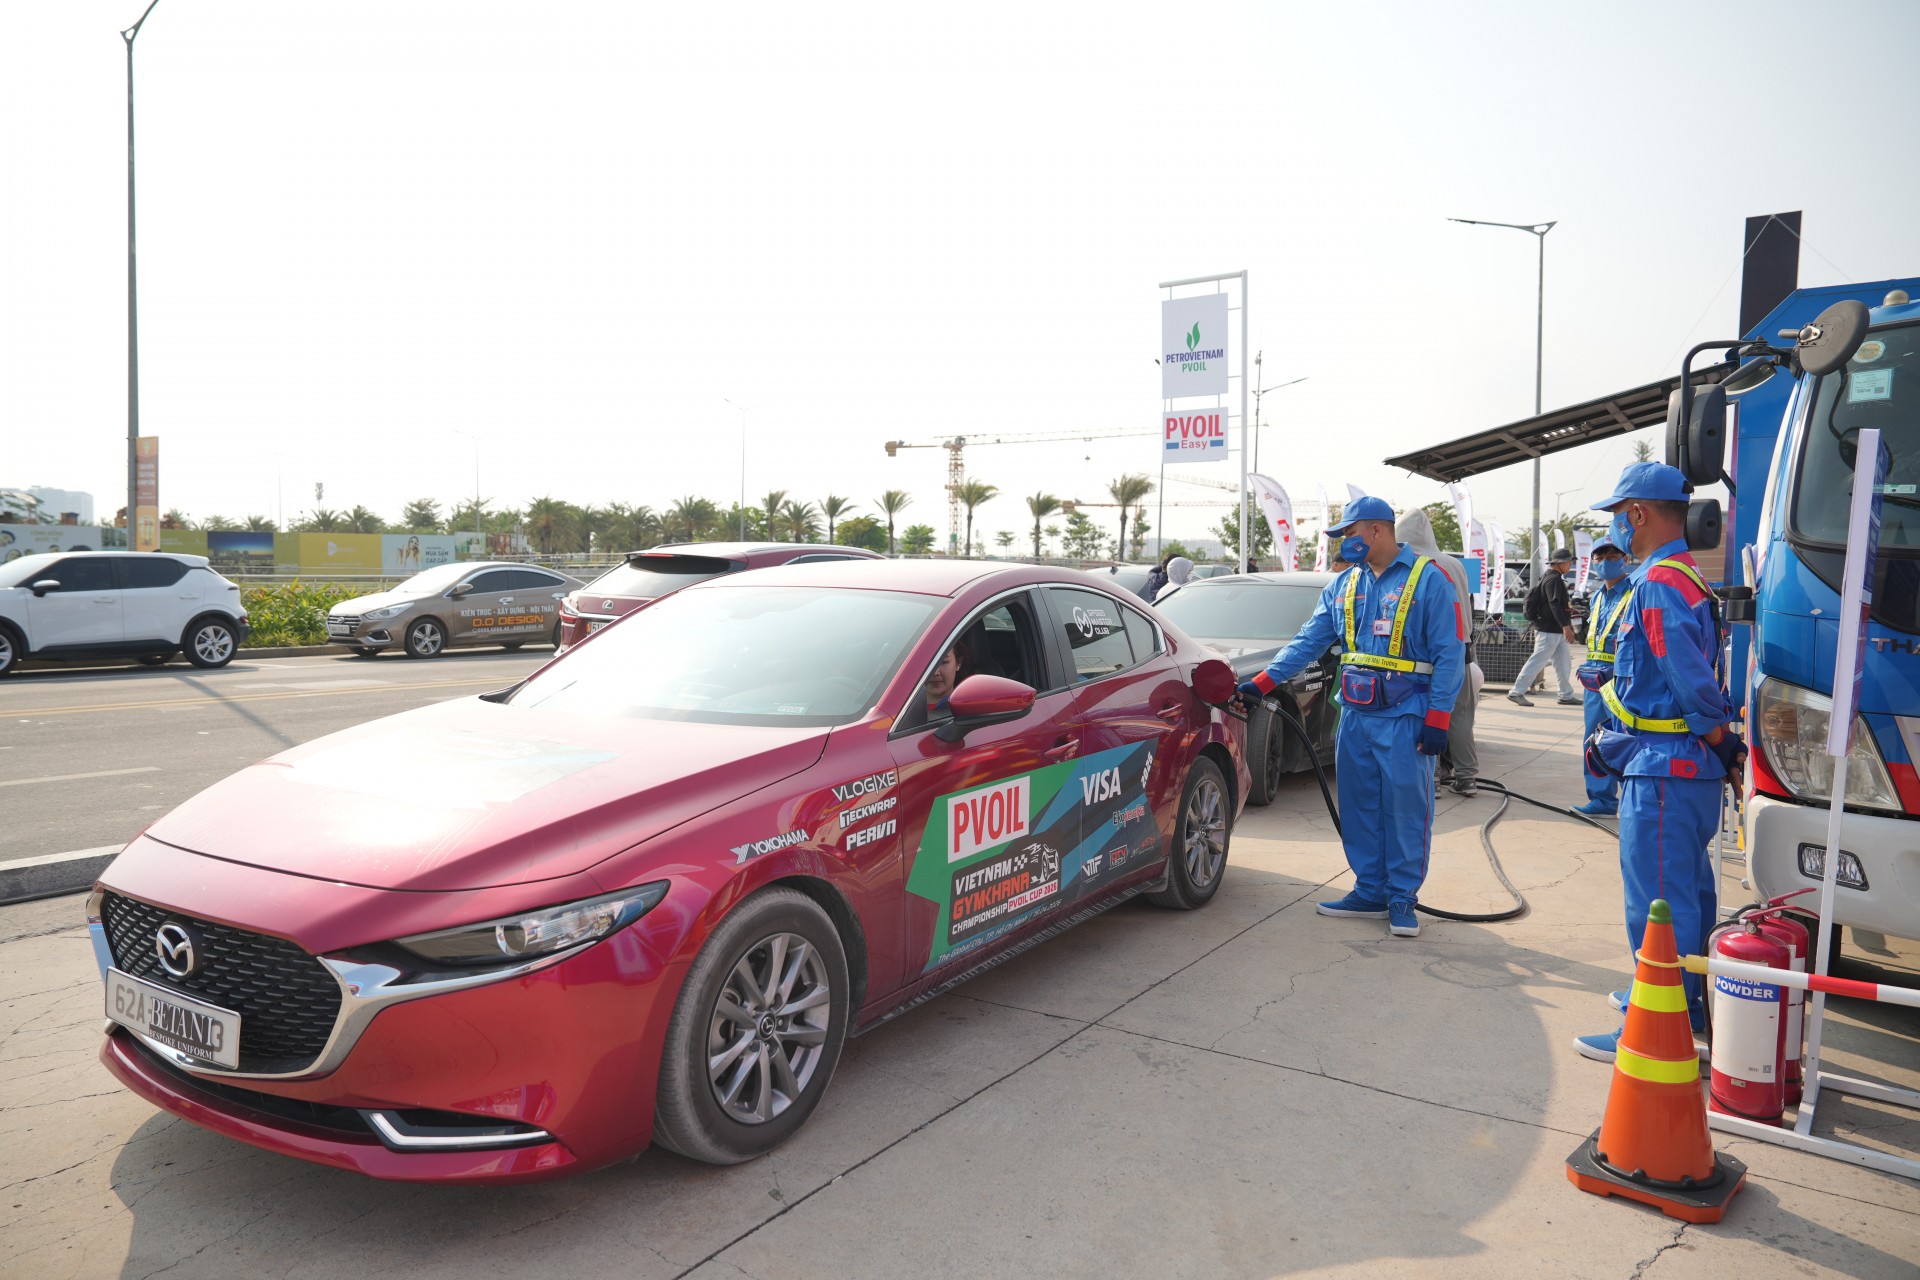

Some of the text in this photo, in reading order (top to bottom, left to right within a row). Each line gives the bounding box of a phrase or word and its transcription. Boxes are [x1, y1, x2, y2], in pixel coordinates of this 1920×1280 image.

[1166, 349, 1224, 364] PETROVIETNAM
[1182, 362, 1207, 372] PVOIL
[1166, 414, 1224, 440] PVOIL
[1181, 440, 1208, 450] Easy
[472, 615, 544, 628] D.O DESIGN
[1079, 767, 1122, 806] VISA
[954, 786, 1024, 854] PVOIL
[750, 828, 810, 856] YOKOHAMA
[956, 858, 1012, 896] VIETNAM
[952, 872, 1030, 920] GYMKHANA
[952, 882, 1057, 935] CHAMPIONSHIP PVOIL CUP 2026
[1716, 976, 1774, 998] POWDER
[150, 997, 214, 1047] BETANI
[150, 1030, 212, 1060] BESPOKE UNIFORM
